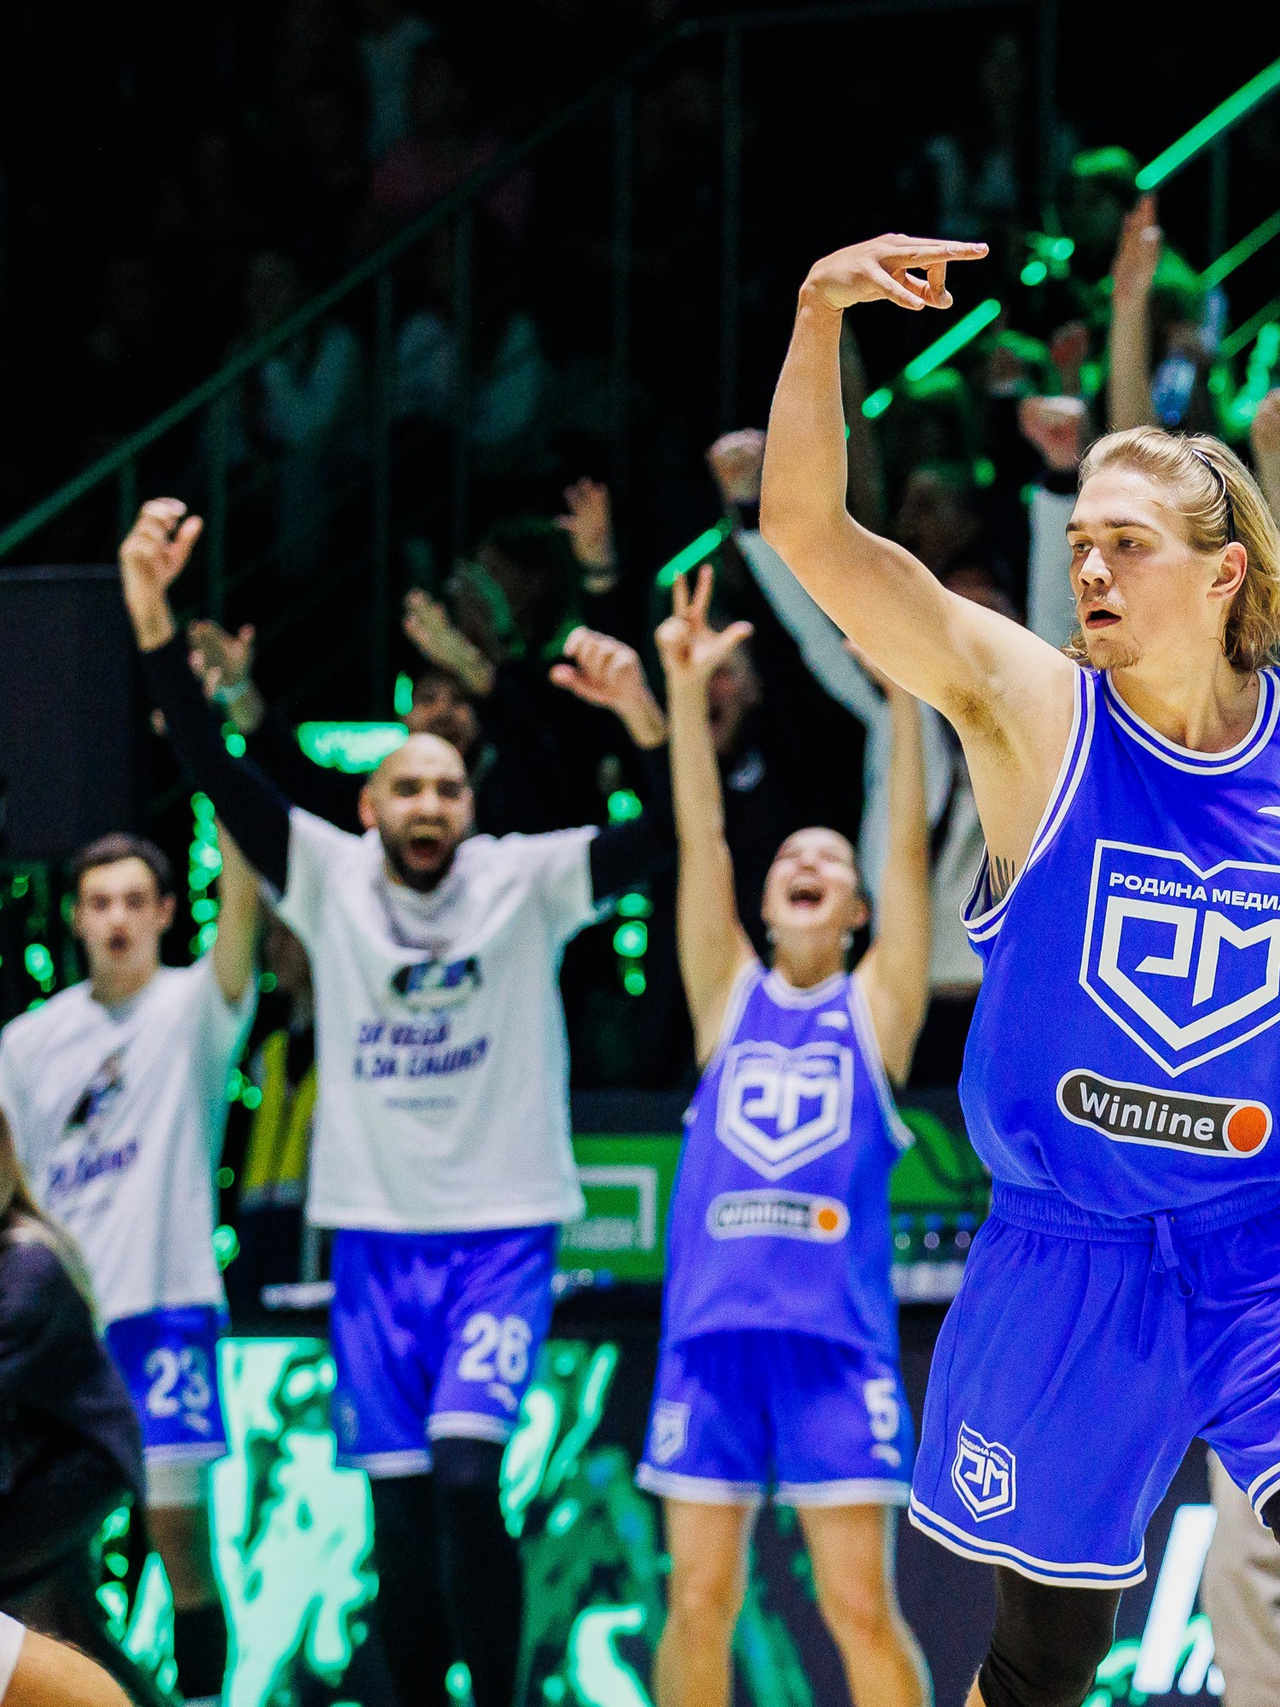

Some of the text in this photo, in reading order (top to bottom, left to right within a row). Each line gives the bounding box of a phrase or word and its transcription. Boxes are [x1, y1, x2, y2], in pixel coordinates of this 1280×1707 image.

[1109, 871, 1208, 902] РОДИНА
[1079, 1081, 1216, 1141] Winline
[144, 1347, 211, 1417] 23
[864, 1378, 900, 1441] 5
